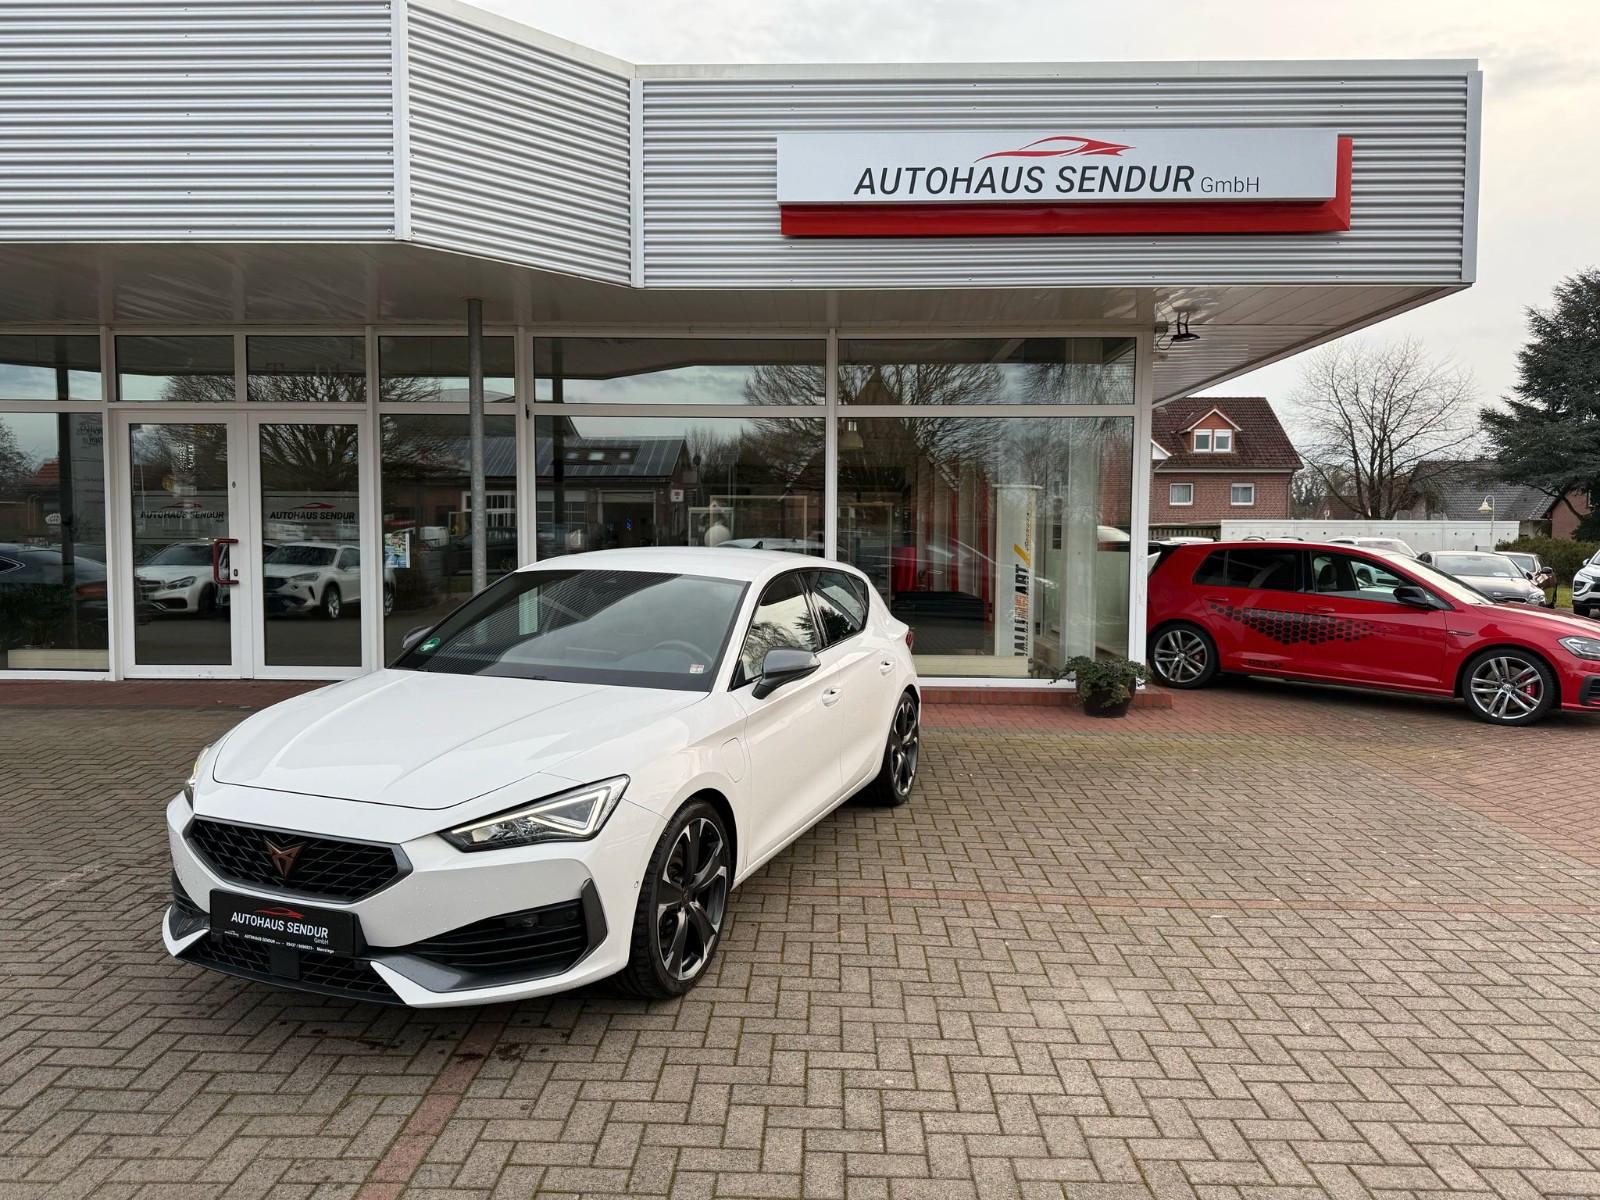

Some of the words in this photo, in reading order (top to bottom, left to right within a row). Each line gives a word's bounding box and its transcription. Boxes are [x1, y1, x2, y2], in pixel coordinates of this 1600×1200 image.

[853, 166, 1046, 195] AUTOHAUS
[1055, 165, 1195, 194] SENDUR
[1200, 176, 1260, 193] GmbH
[270, 511, 318, 520] AUTOHAUS
[319, 511, 356, 520] SENDUR
[231, 911, 285, 931] AUTOHAUS
[286, 922, 329, 939] SENDUR
[313, 937, 329, 945] GmbH
